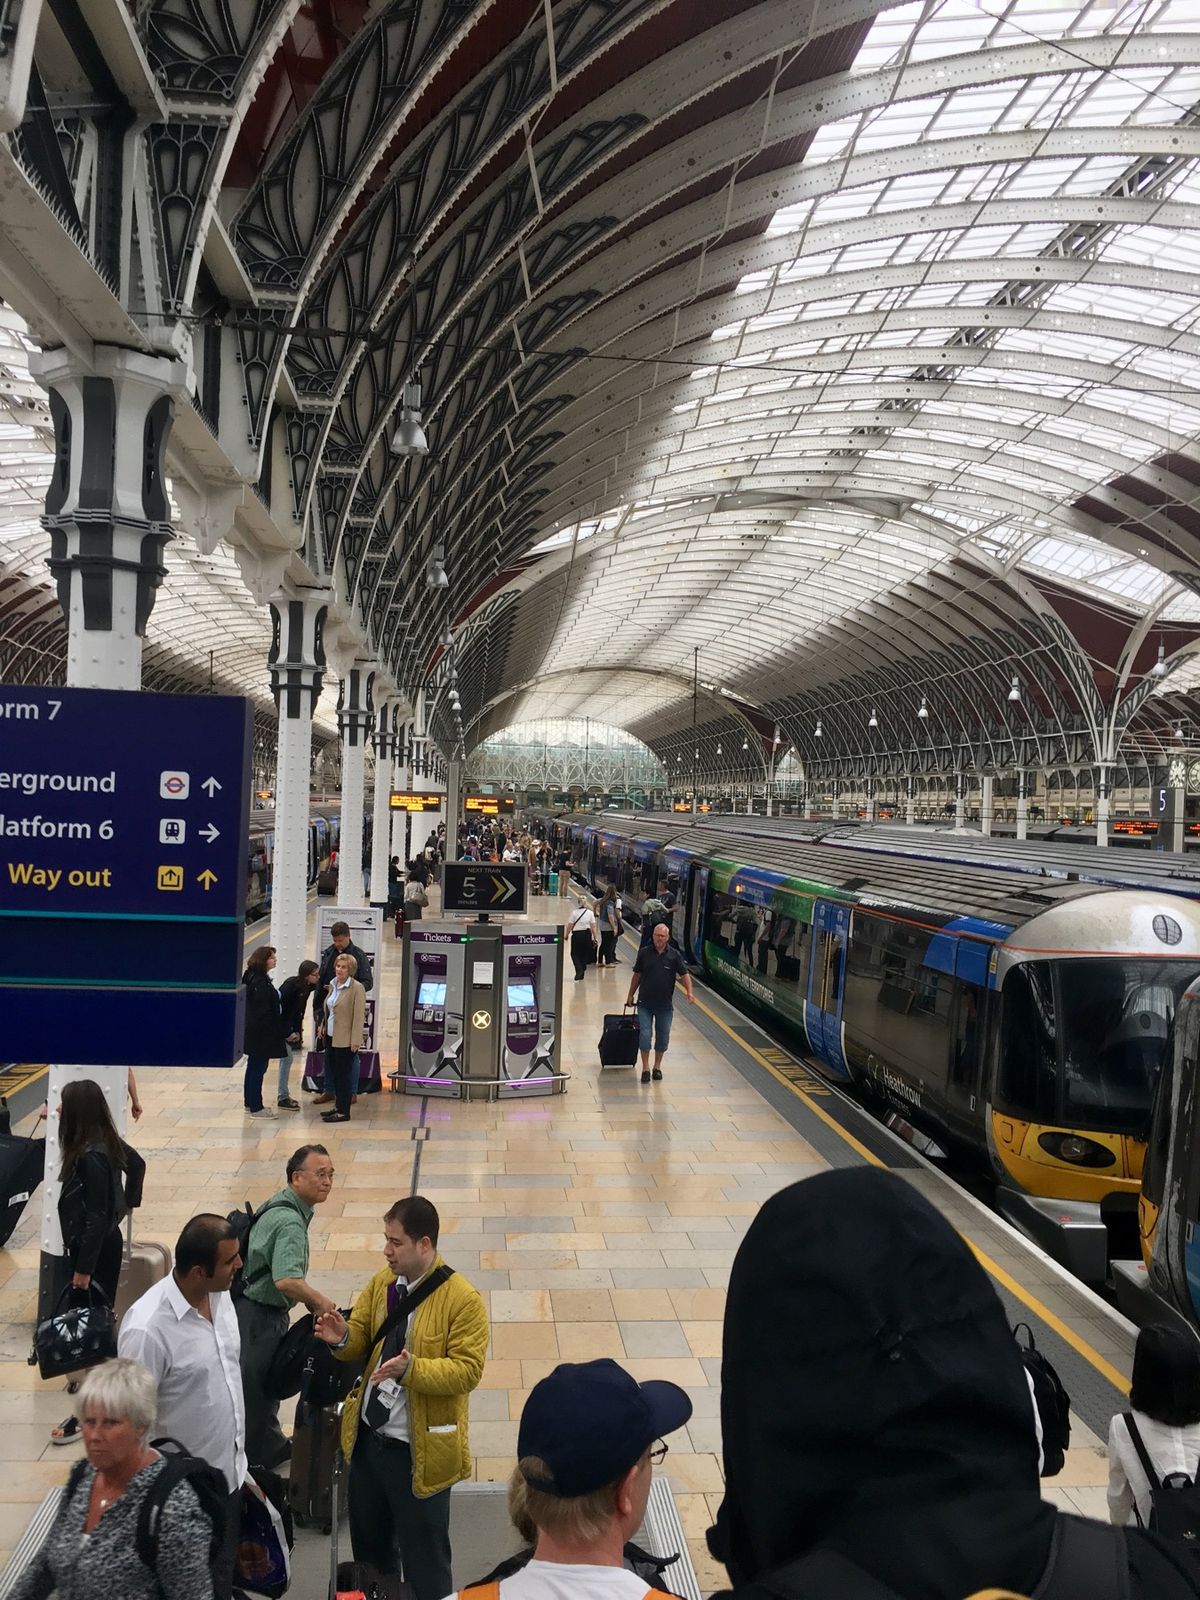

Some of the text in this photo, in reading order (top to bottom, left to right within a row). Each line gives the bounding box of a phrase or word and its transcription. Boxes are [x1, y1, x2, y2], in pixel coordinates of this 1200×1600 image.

[47, 701, 62, 721] 7
[1159, 789, 1167, 812] 5
[98, 819, 114, 840] 6
[8, 863, 112, 892] Way out
[462, 876, 477, 898] 5
[423, 932, 452, 943] Tickets
[517, 935, 546, 944] Tickets
[882, 1064, 922, 1109] Heathrow
